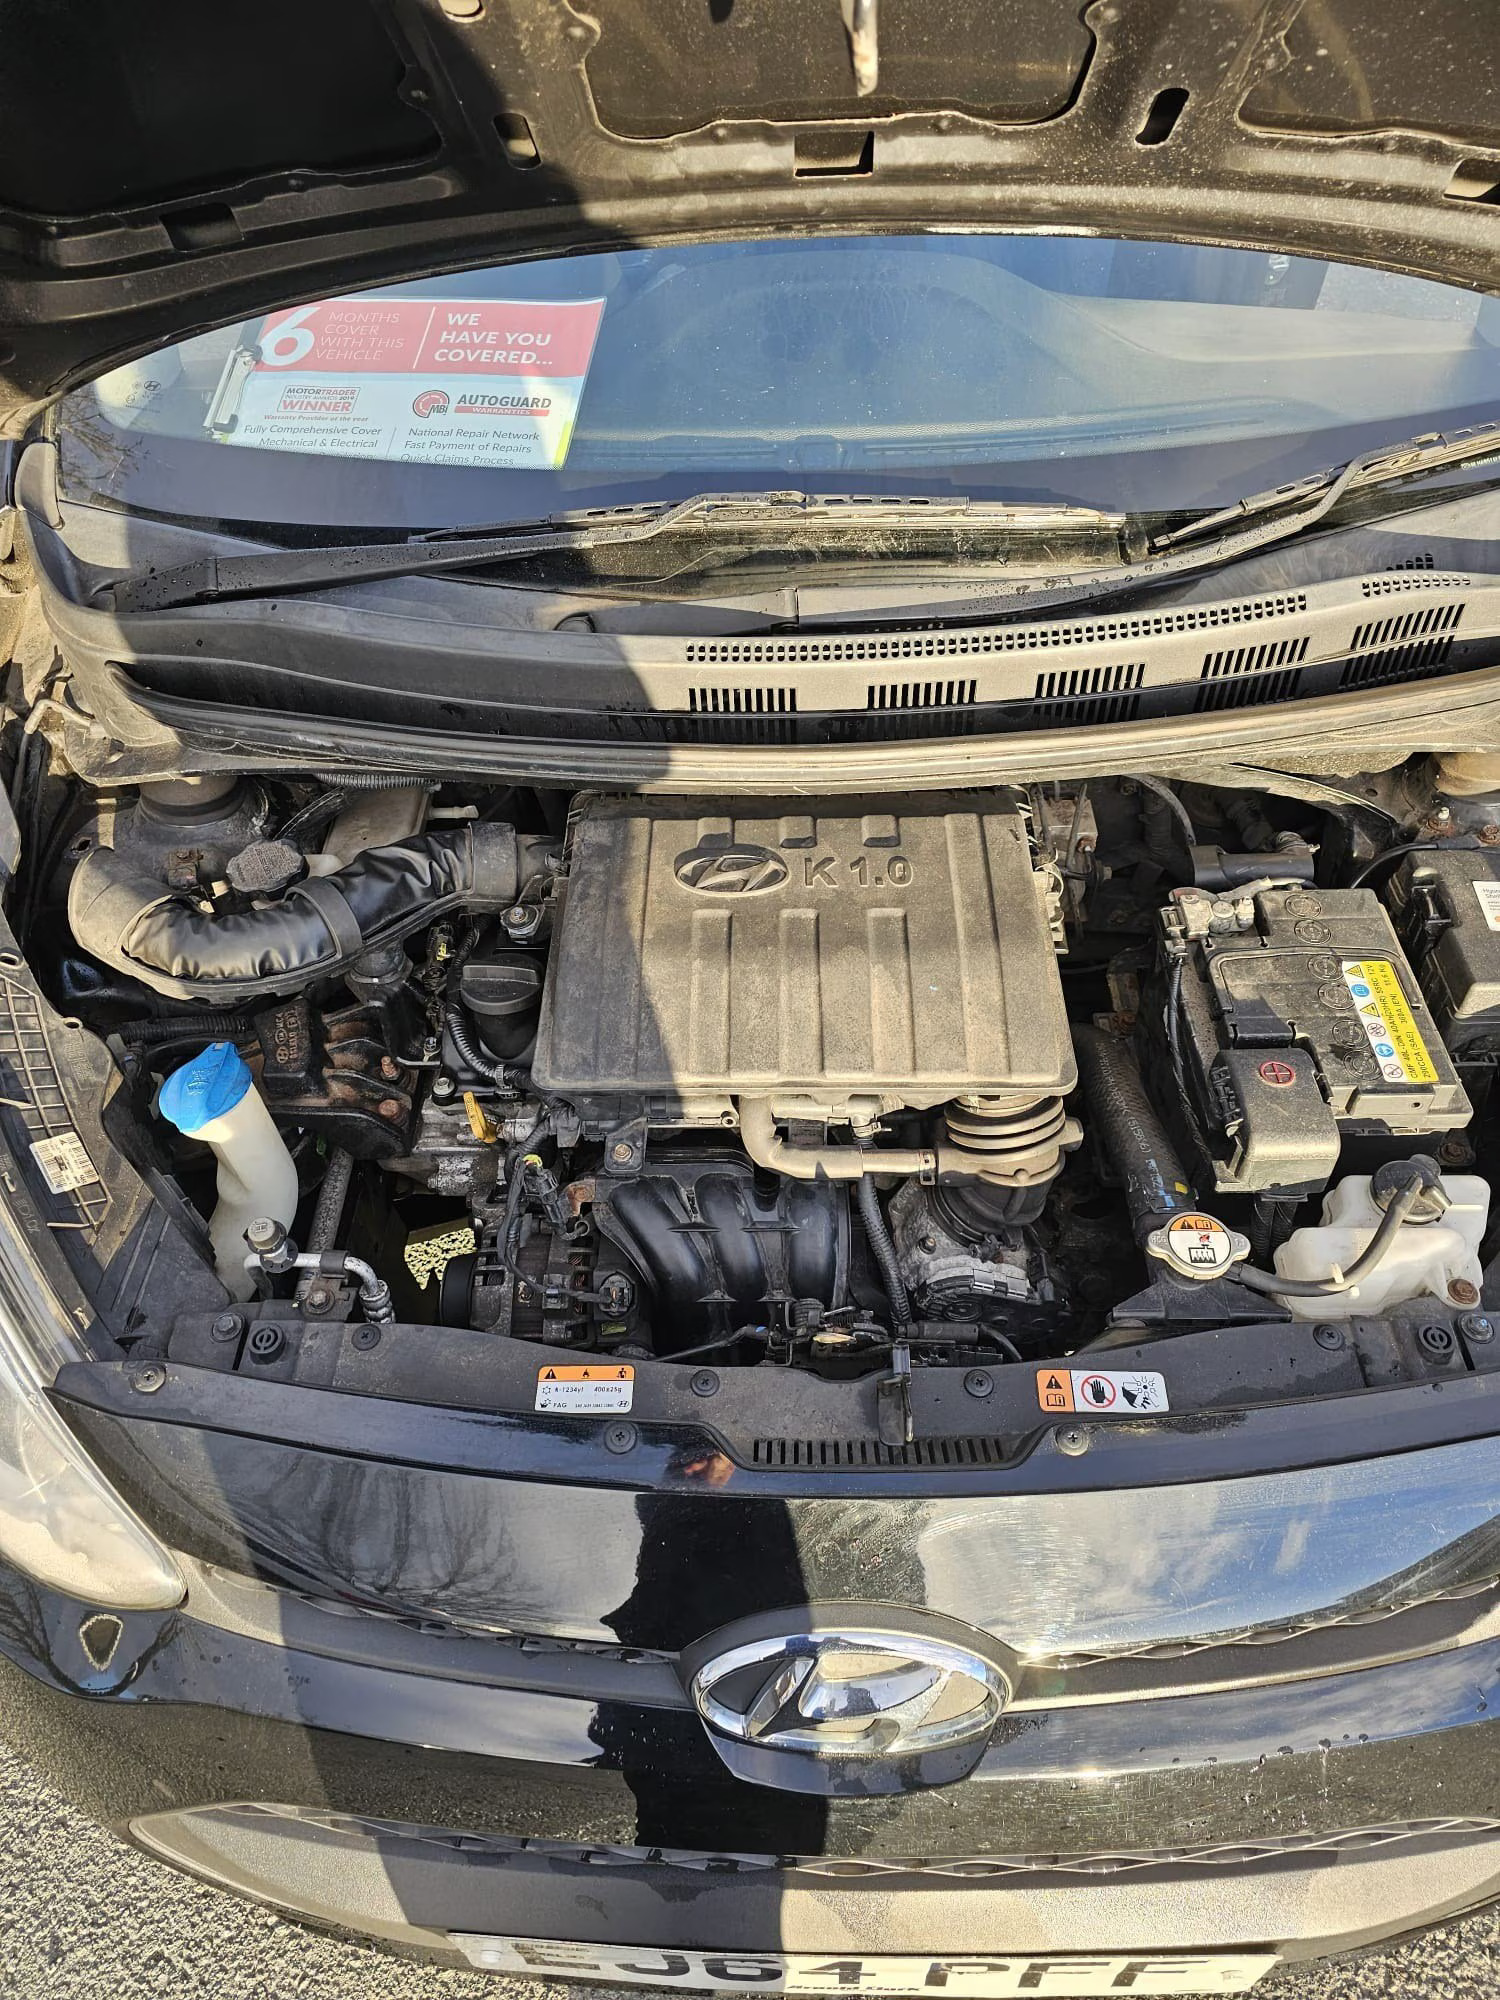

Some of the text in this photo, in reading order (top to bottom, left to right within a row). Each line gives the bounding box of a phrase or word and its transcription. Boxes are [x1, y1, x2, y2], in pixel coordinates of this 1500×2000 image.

[328, 311, 400, 323] MONTHS
[448, 313, 482, 326] WE
[261, 306, 322, 366] 6
[324, 324, 380, 335] COVER
[320, 336, 405, 348] WITH THIS
[440, 331, 552, 346] HAVE YOU
[315, 349, 383, 361] VEHICLE
[434, 349, 553, 365] COVERED...
[282, 400, 352, 412] WINNER
[457, 394, 552, 409] AUTOGUARD
[472, 407, 531, 415] WARRANTIES
[244, 424, 382, 435] Fully Comprehensive Cover
[408, 427, 540, 441] National Repair Network
[259, 437, 379, 448] Mechanical & Electrical
[404, 440, 532, 454] Fast Payment of Repairs
[434, 453, 470, 464] Claims
[472, 455, 515, 466] Process
[803, 855, 914, 888] K 1.0
[924, 1959, 1210, 1988] PFF
